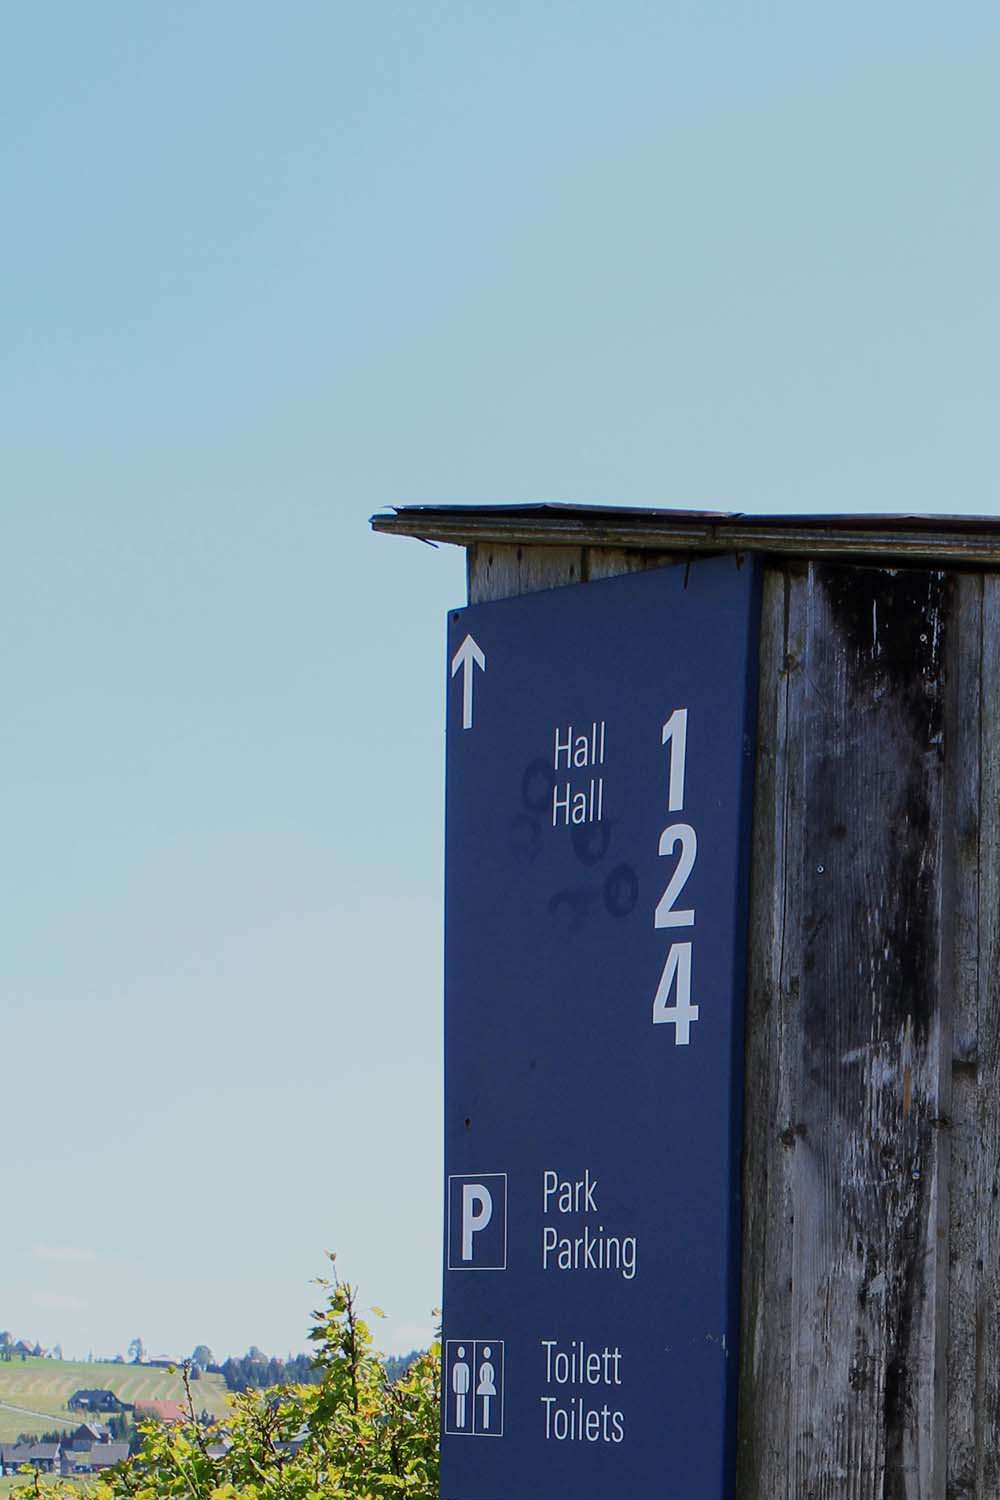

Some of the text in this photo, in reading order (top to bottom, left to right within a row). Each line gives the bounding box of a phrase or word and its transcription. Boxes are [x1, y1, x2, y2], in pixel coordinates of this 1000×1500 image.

[555, 721, 604, 770] Hall
[662, 709, 687, 811] 1
[553, 779, 602, 826] Hall
[655, 824, 696, 928] 2
[653, 942, 698, 1045] 4
[544, 1170, 597, 1212] Park
[463, 1184, 492, 1260] P
[544, 1226, 636, 1279] Parking
[542, 1341, 621, 1384] Toilett
[541, 1397, 623, 1442] Toilets
